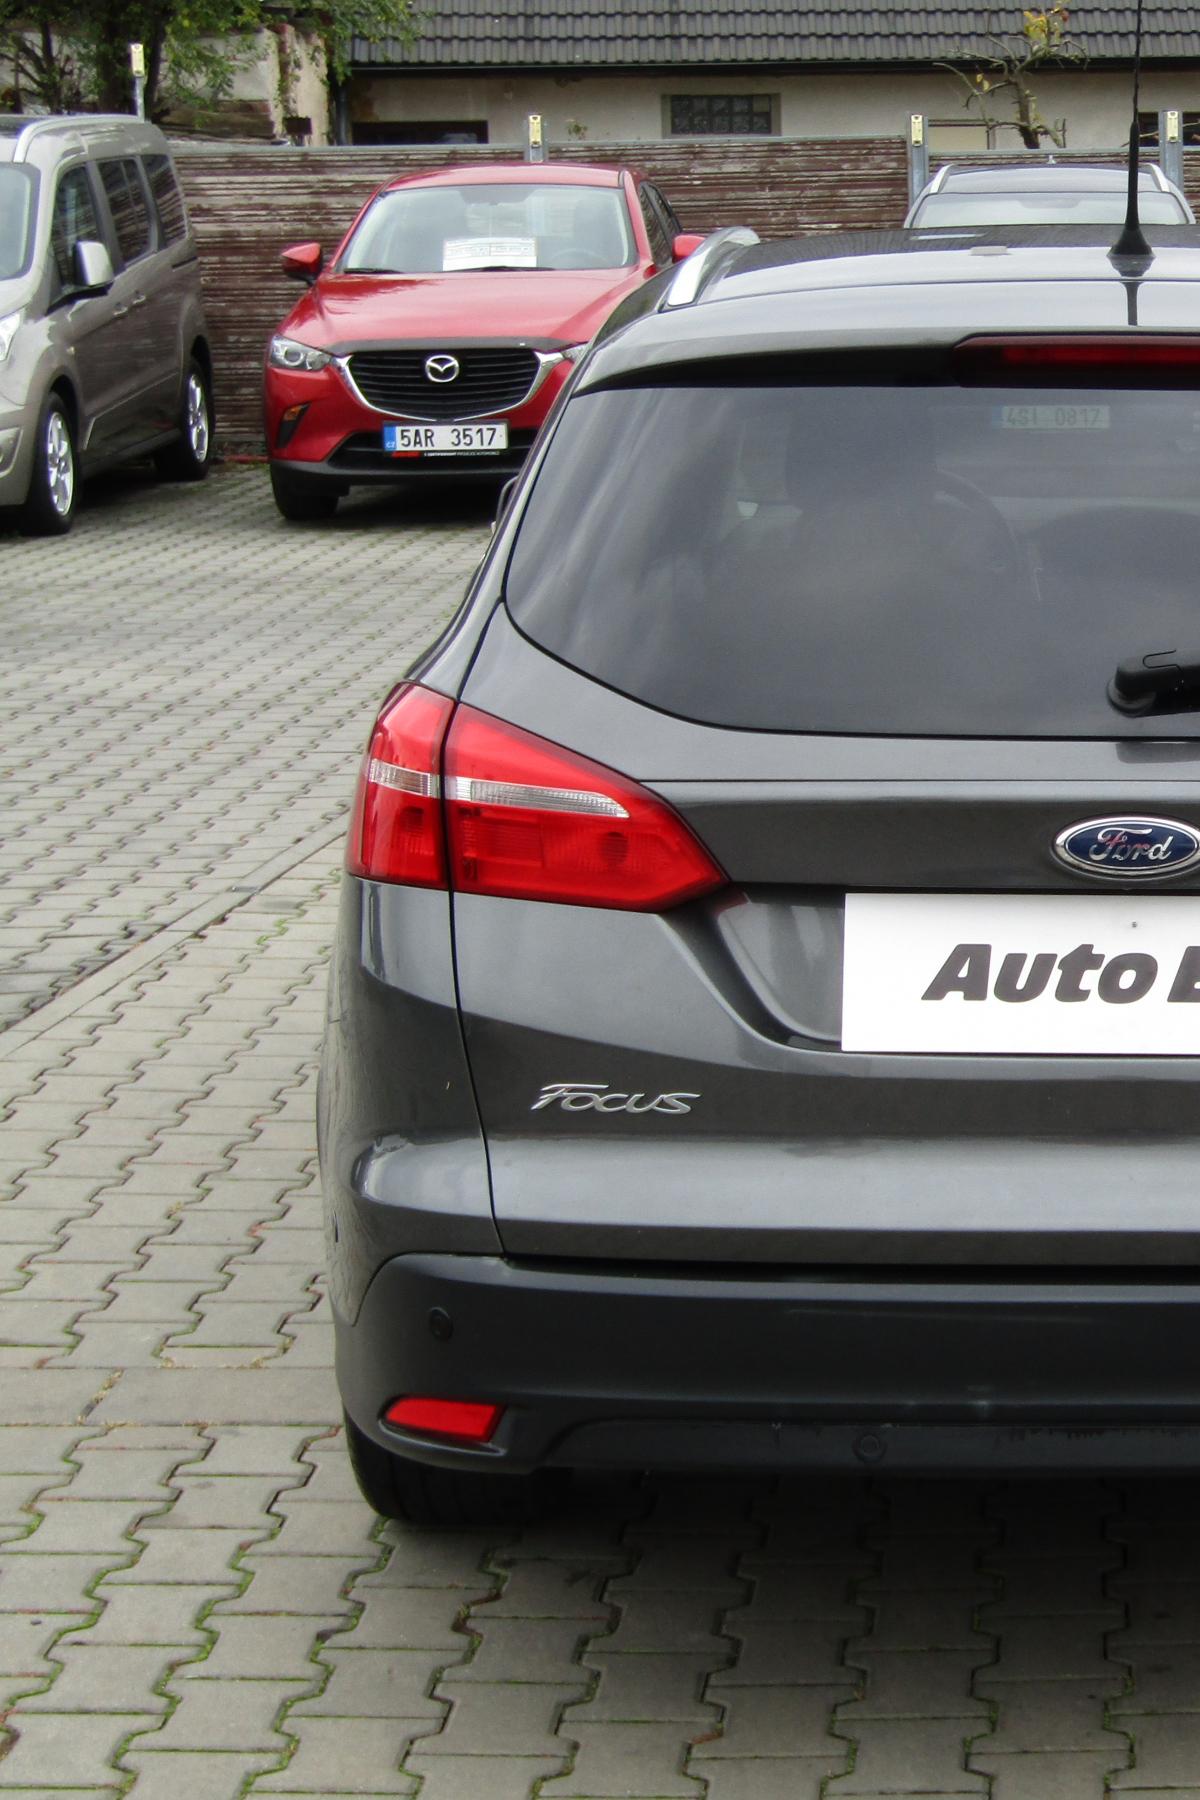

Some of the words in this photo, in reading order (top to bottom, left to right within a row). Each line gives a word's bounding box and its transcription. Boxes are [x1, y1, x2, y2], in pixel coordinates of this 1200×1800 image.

[1055, 407, 1100, 426] 0817
[400, 429, 435, 448] 5AR
[451, 428, 497, 446] 3517
[1089, 827, 1174, 861] Ford
[921, 944, 1158, 1004] Auto
